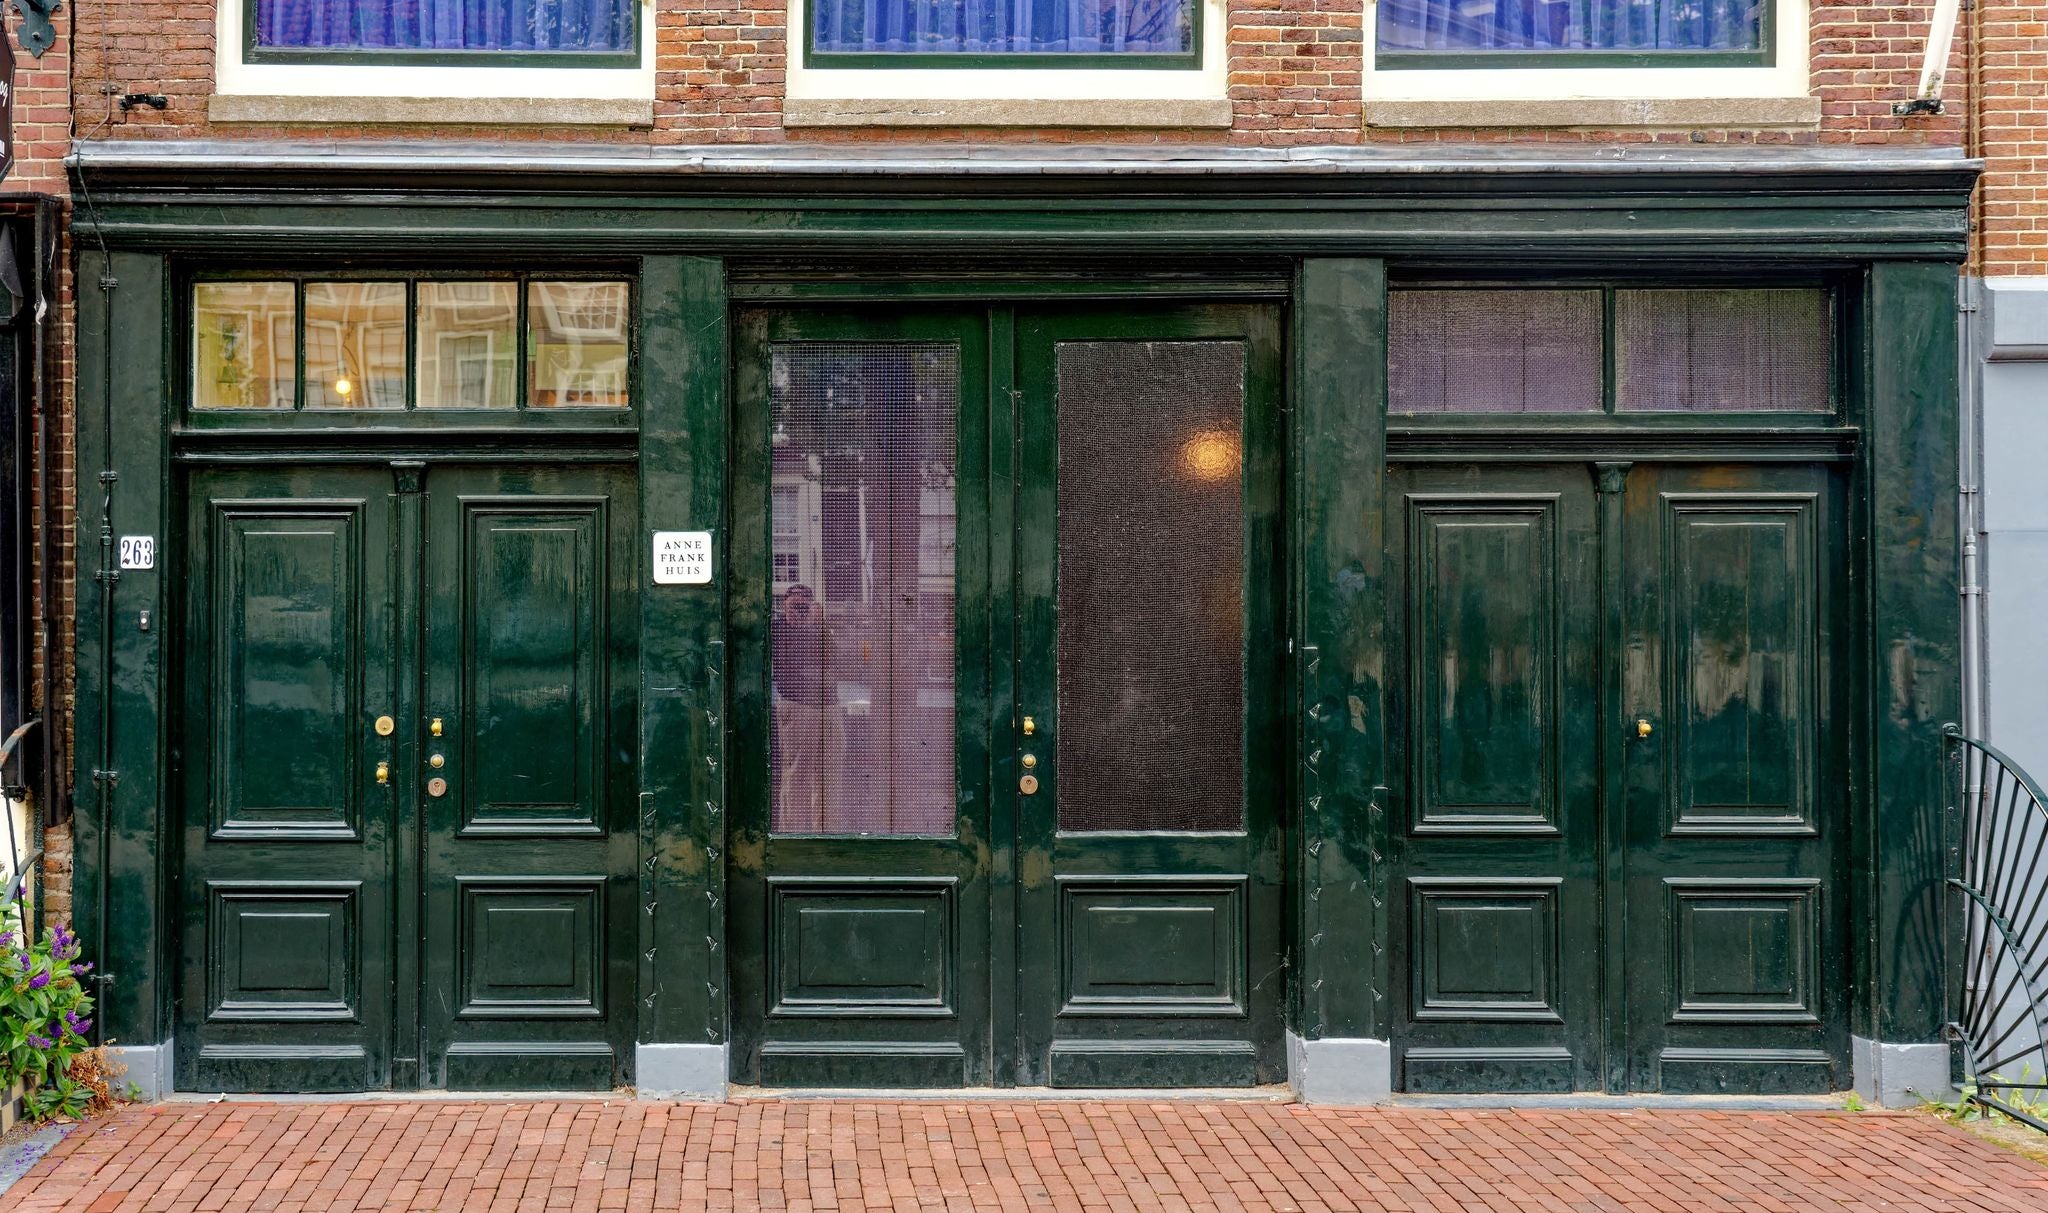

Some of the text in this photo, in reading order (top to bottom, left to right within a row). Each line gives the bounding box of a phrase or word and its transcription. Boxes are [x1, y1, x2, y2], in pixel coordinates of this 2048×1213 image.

[664, 540, 702, 550] ANNE
[122, 540, 153, 565] 263
[660, 553, 705, 562] FRANK
[666, 566, 700, 575] HUIS
